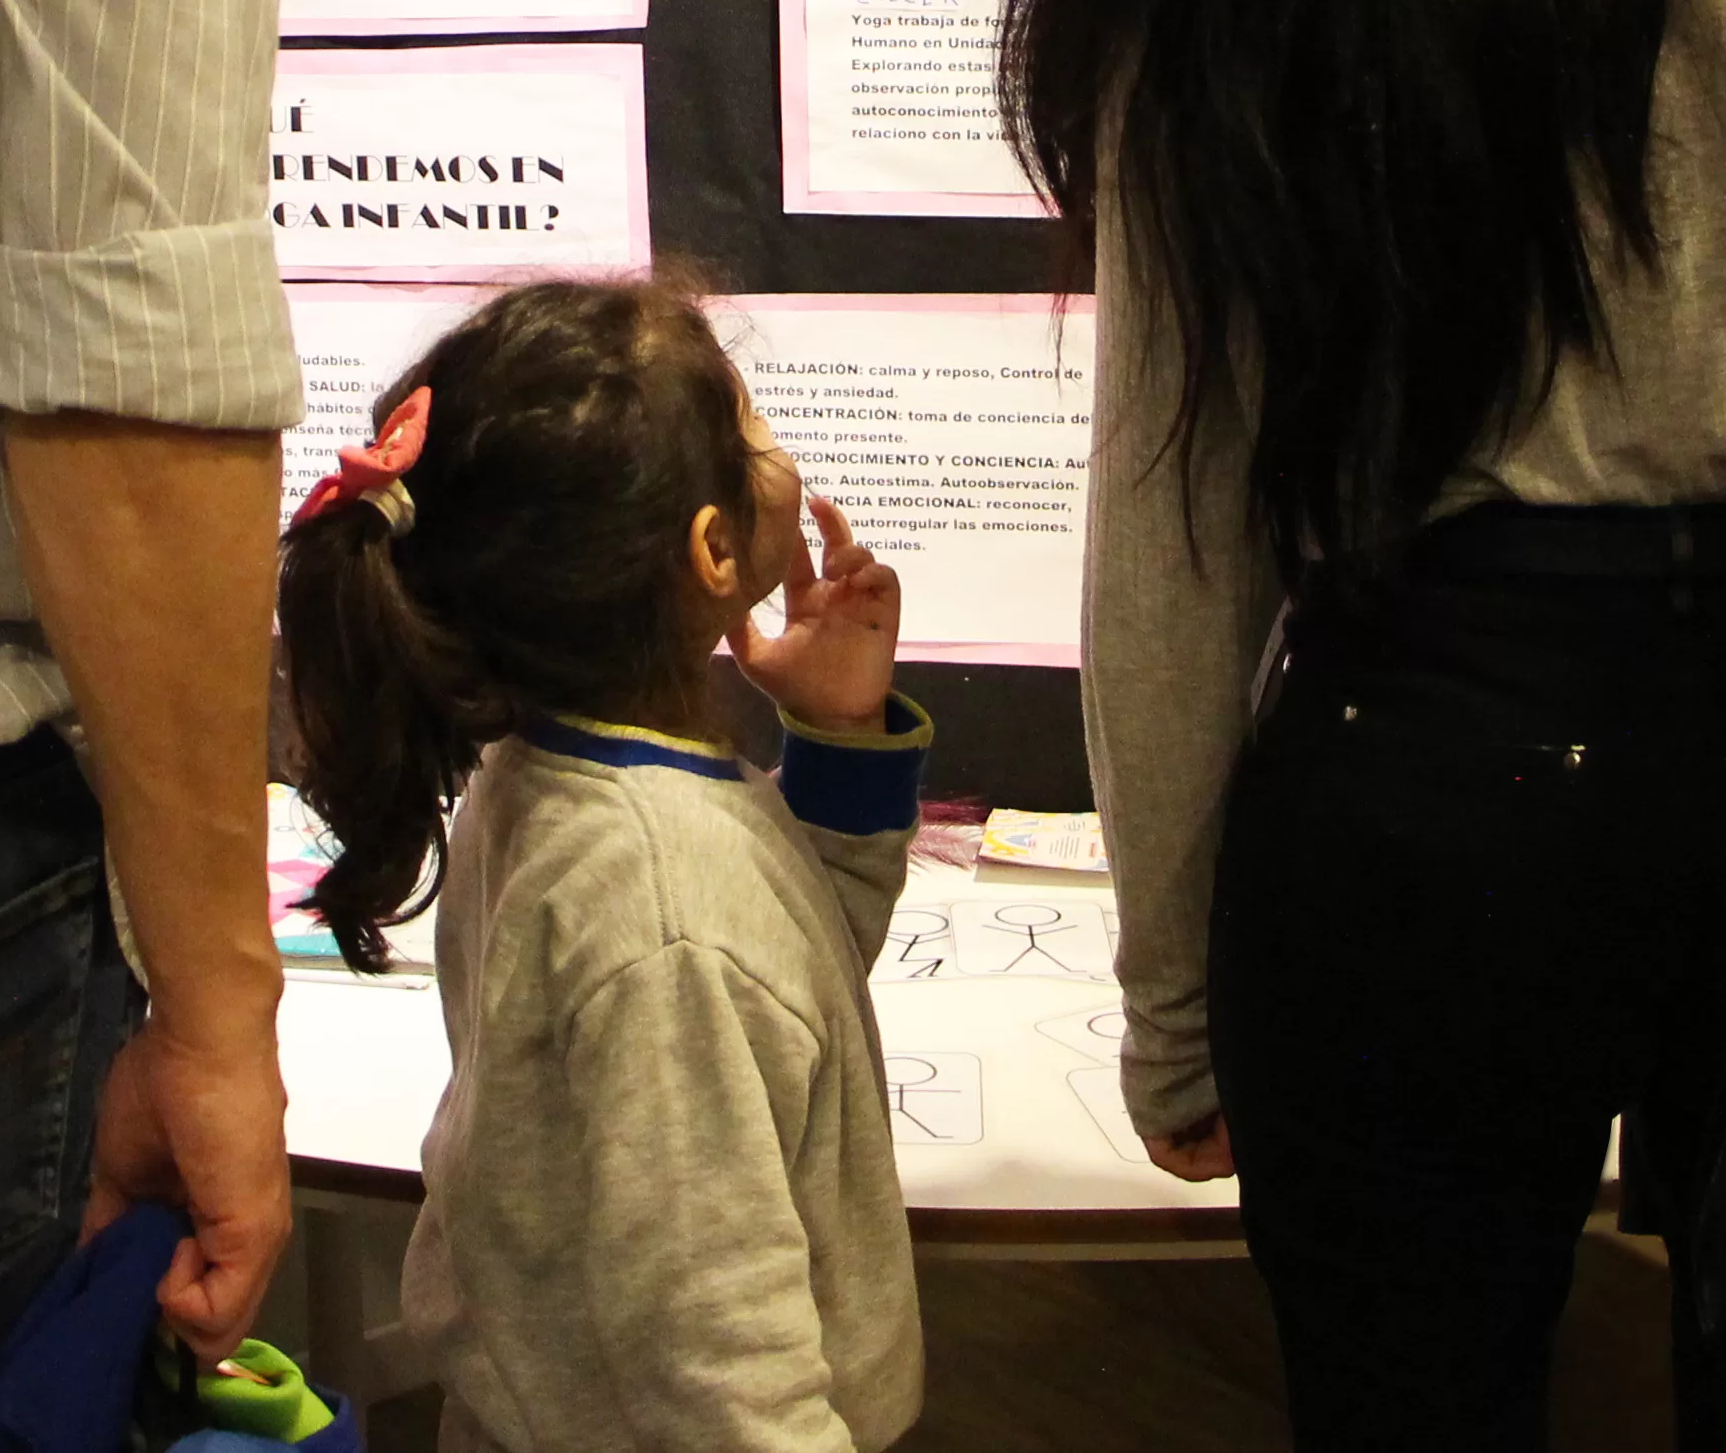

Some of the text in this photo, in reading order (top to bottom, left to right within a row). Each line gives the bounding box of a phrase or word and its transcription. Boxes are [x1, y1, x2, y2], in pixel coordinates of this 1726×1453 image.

[851, 14, 892, 29] Yoga
[897, 15, 955, 30] trabaja
[960, 15, 980, 27] de
[851, 35, 918, 49] Humano
[922, 39, 943, 49] en
[851, 58, 992, 74] Explorando estas
[850, 81, 950, 95] observación
[851, 127, 927, 140] relaciono
[931, 130, 961, 141] con
[966, 129, 981, 141] la
[273, 153, 565, 184] RENDEMOS EN
[272, 201, 559, 233] GA INFANTIL?
[298, 354, 366, 367] ludables.
[754, 359, 863, 376] RELAJACIÓN:
[868, 364, 917, 377] calma
[922, 368, 931, 380] y
[935, 368, 995, 381] reposo,
[1063, 368, 1083, 381] de
[309, 380, 365, 393] SALUD:
[754, 385, 899, 400] estrés y ansiedad.
[907, 410, 948, 423] toma
[952, 411, 973, 423] de
[977, 412, 1066, 425] conciencia
[771, 431, 908, 445] omento presente.
[790, 452, 929, 466] OCONOCIMIENTO
[935, 454, 946, 467] Y
[950, 455, 1059, 469] CONCIENCIA:
[839, 474, 935, 488] Autoestima.
[940, 476, 1080, 491] Autoobservación.
[878, 496, 981, 509] EMOCIONAL:
[986, 501, 1072, 514] reconocer,
[847, 517, 1073, 534] autorregular las emociones.
[856, 539, 927, 552] sociales.
